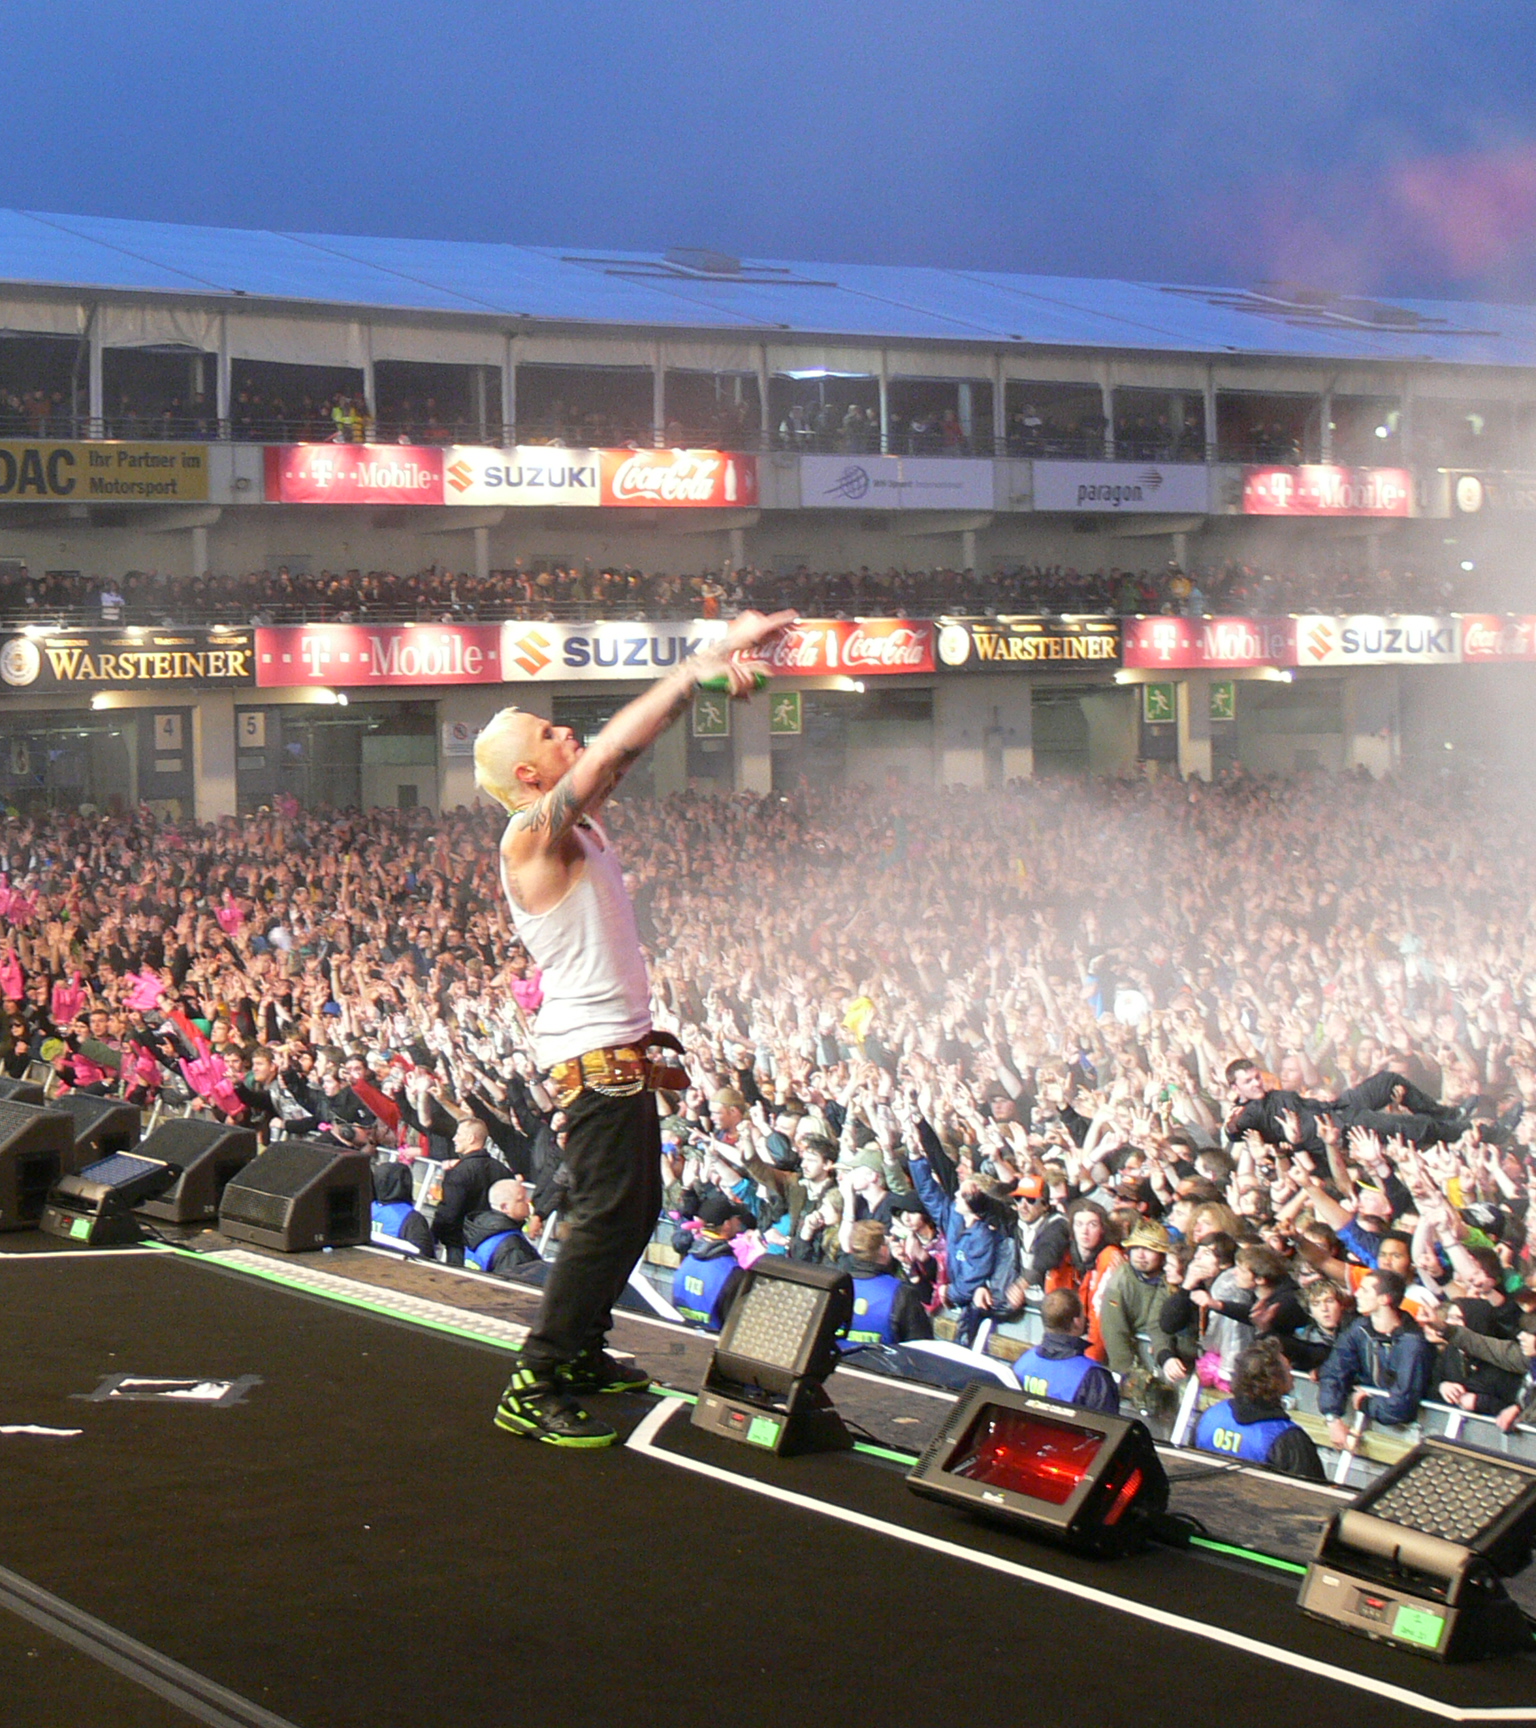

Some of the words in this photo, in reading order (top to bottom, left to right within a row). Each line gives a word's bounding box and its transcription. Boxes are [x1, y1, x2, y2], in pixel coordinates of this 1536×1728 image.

[89, 450, 113, 468] Ihr
[118, 451, 175, 468] Partner
[181, 451, 202, 468] im
[89, 476, 178, 496] Motorsport
[357, 461, 431, 489] Mobile
[484, 466, 596, 488] SUZUKI
[1077, 484, 1143, 507] paragon
[1318, 474, 1397, 510] Mobile
[563, 636, 708, 667] SUZUK
[1203, 622, 1283, 660] Mobile
[1342, 628, 1454, 654] SUZUKI
[368, 634, 483, 676] Mobile
[163, 719, 174, 737] 4
[247, 717, 257, 735] 5
[1213, 1427, 1242, 1454] 051
